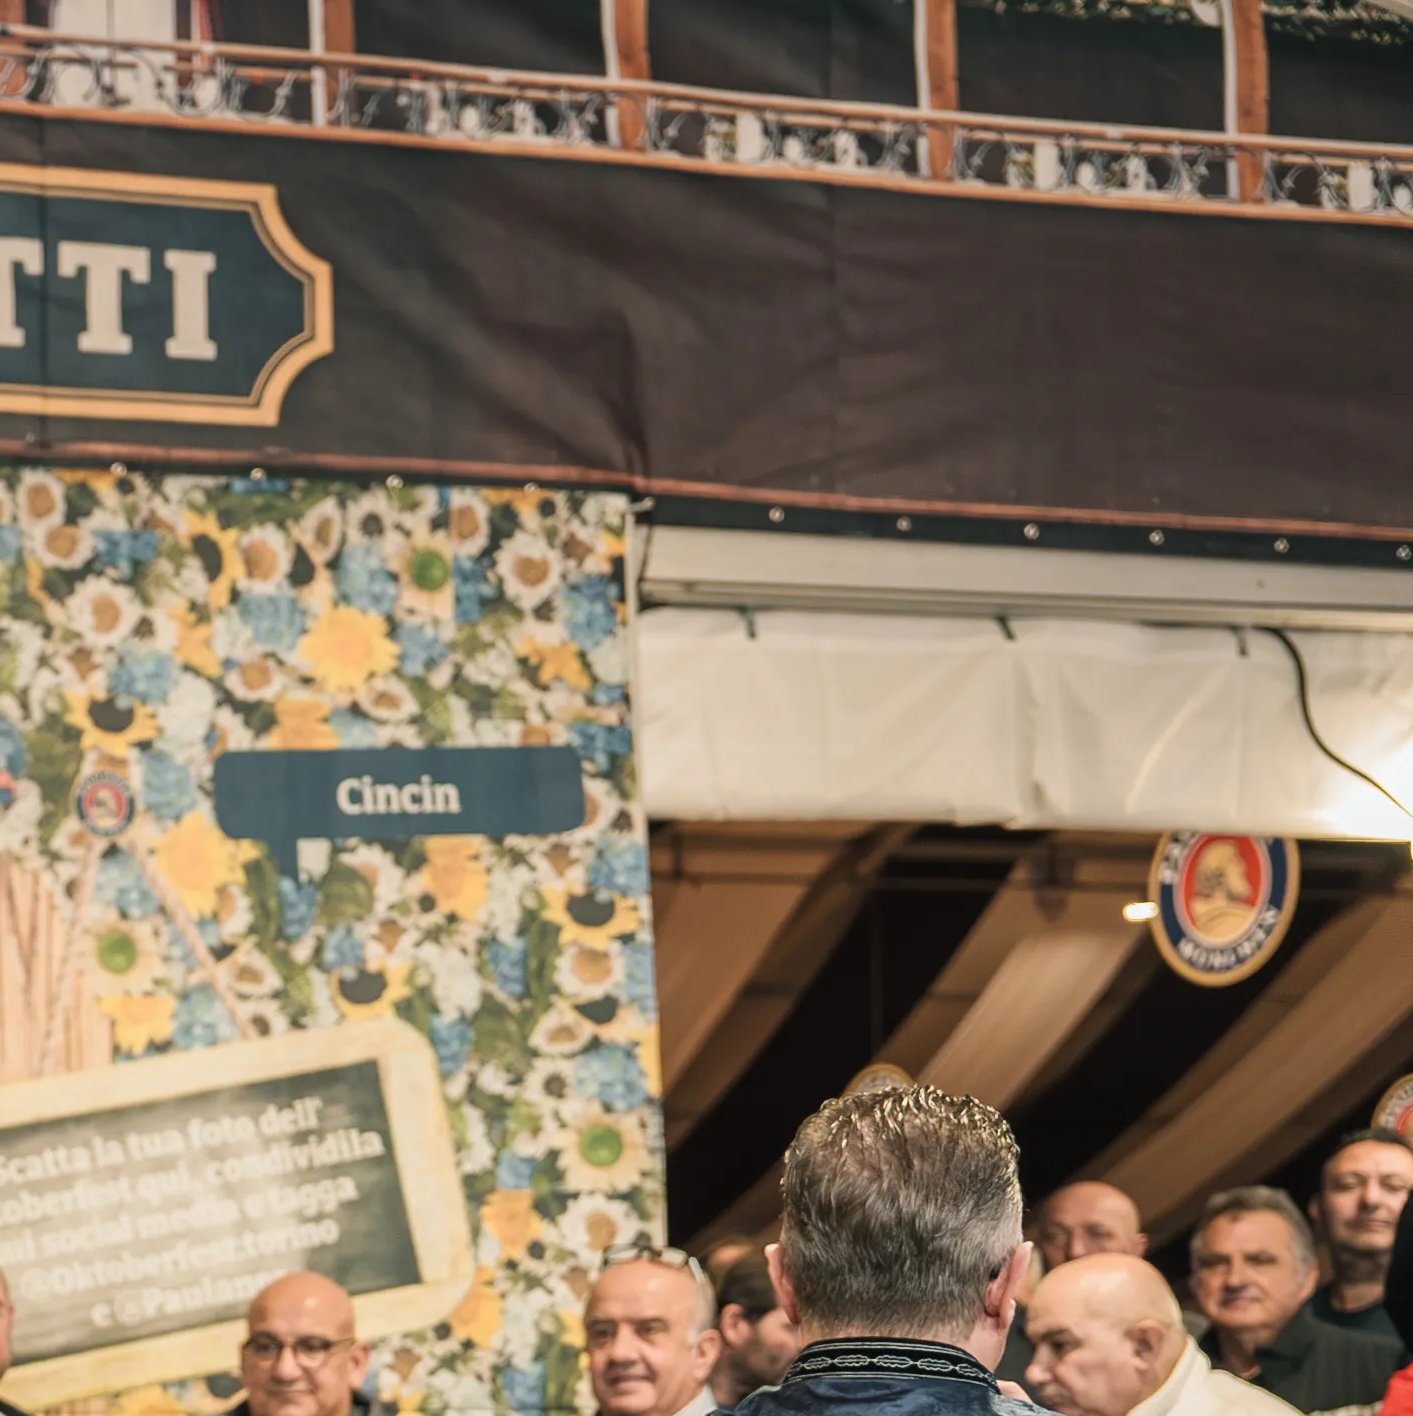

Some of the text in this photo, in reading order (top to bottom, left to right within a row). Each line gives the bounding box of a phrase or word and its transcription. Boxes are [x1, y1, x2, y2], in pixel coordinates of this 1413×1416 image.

[336, 776, 462, 816] Cincin
[92, 1136, 124, 1167] la
[126, 1129, 185, 1161] tua
[187, 1114, 255, 1149] foto
[205, 1127, 386, 1184] condividila
[114, 1269, 291, 1327] @Paulan
